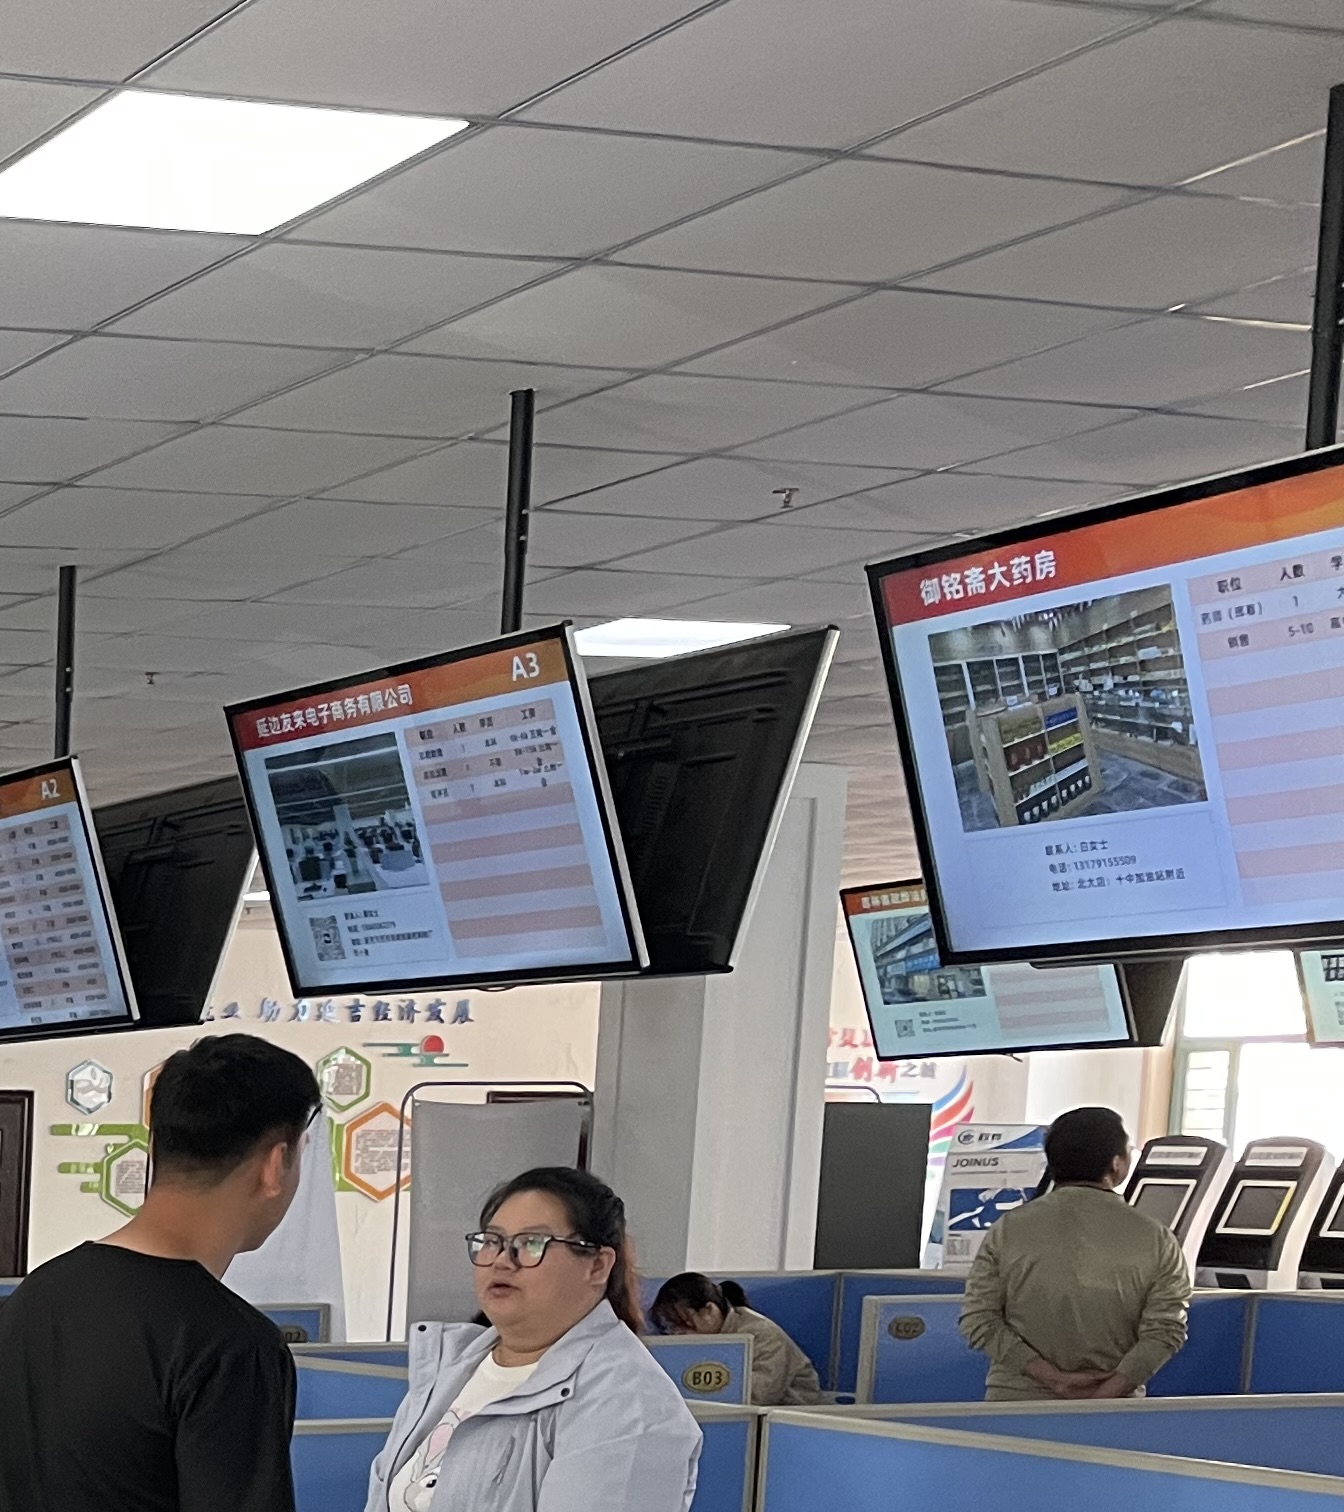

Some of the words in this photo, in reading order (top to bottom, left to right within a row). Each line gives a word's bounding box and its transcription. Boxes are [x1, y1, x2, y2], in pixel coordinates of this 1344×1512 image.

[919, 550, 1057, 606] 御铭斋大药房
[512, 652, 539, 682] A3
[41, 779, 60, 800] A2
[952, 1157, 999, 1168] JOINUS
[691, 1369, 723, 1387] B03
